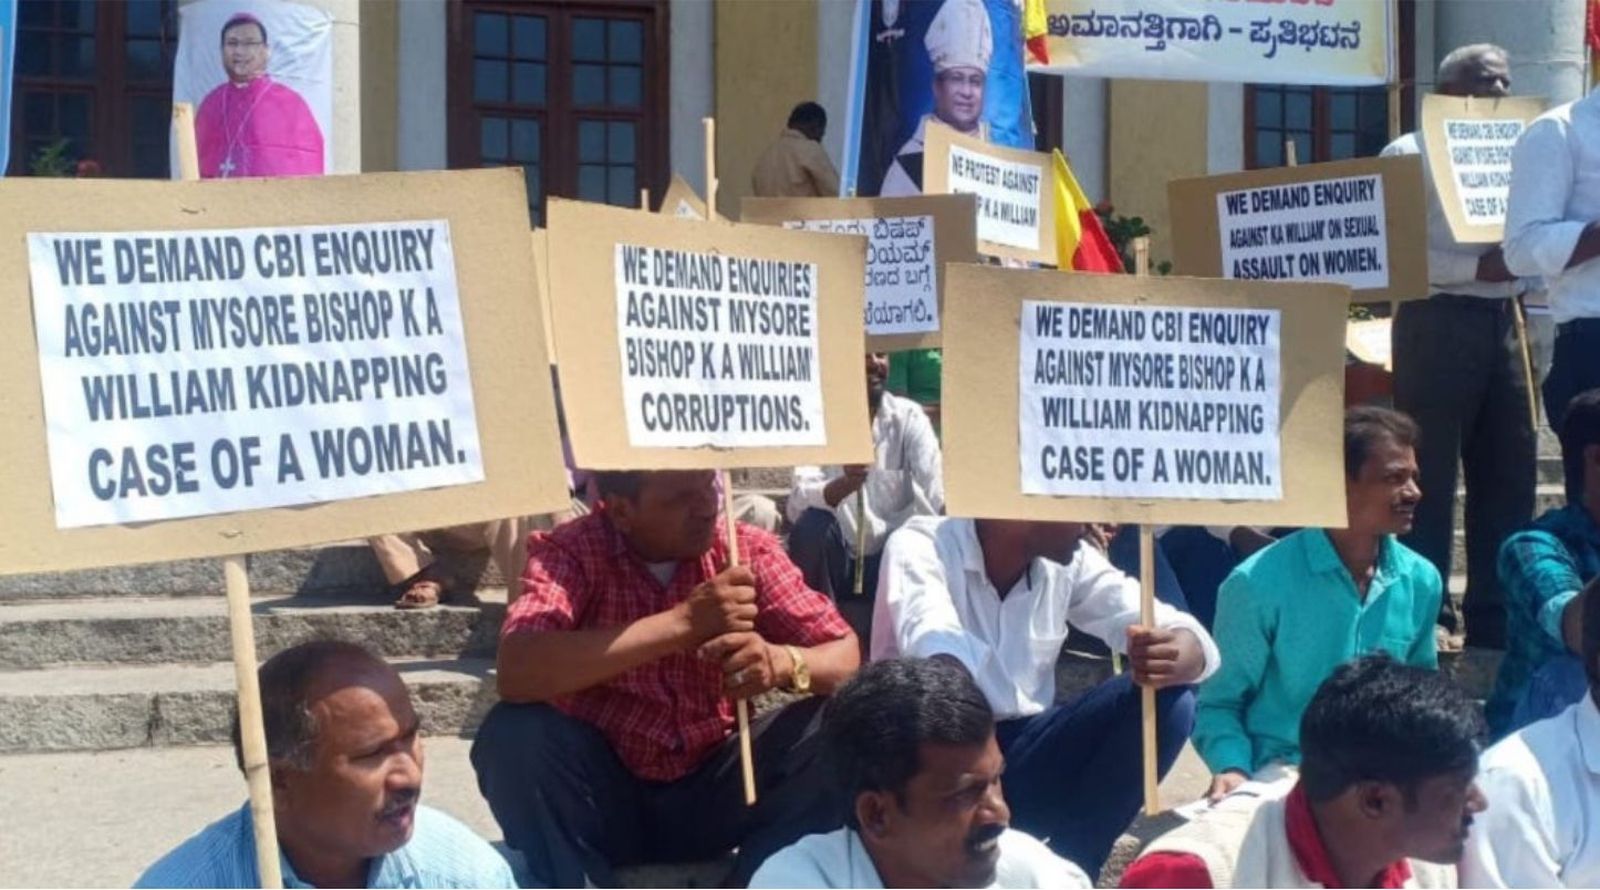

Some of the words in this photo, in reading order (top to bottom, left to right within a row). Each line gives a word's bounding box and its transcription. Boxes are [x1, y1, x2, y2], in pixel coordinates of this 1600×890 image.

[1249, 16, 1361, 58] ಪ್ರತಿಭಟನೆ
[965, 158, 1000, 185] PROTEST
[1002, 169, 1038, 194] AGAINST
[993, 200, 999, 219] A
[1001, 202, 1037, 227] WILLIAM
[1226, 193, 1248, 216] WE
[1252, 186, 1310, 213] DEMAND
[1314, 178, 1376, 206] ENQUIRY
[1230, 225, 1268, 249] AGAINST
[1328, 217, 1342, 240] ON
[1344, 214, 1380, 238] SEXUAL
[53, 239, 106, 286] WE
[114, 236, 246, 285] DEMAND
[254, 233, 305, 279] CBI
[313, 228, 435, 277] ENQUIRY
[623, 245, 648, 286] WE
[653, 248, 723, 292] DEMAND
[728, 256, 811, 299] ENQUIRIES
[1234, 254, 1296, 280] ASSAULT
[1299, 252, 1320, 277] ON
[1323, 247, 1382, 275] WOMEN.
[65, 300, 181, 357] AGAINST
[189, 295, 300, 350] MYSORE
[304, 290, 394, 343] BISHOP
[400, 288, 422, 337] K
[426, 287, 443, 335] A
[626, 290, 722, 332] AGAINST
[729, 298, 811, 337] MYSORE
[1036, 305, 1063, 338] WE
[1069, 307, 1146, 341] DEMAND
[1152, 311, 1183, 343] CBI
[1189, 313, 1270, 345] ENQUIRY
[626, 337, 695, 379] BISHOP
[701, 341, 716, 379] K
[721, 343, 734, 379] A
[1034, 348, 1104, 387] AGAINST
[1108, 352, 1174, 389] MYSORE
[1179, 354, 1235, 391] BISHOP
[1240, 356, 1251, 392] K
[1255, 357, 1266, 392] A
[81, 367, 237, 422] WILLIAM
[246, 352, 447, 410] KIDNAPPING
[641, 392, 810, 432] CORRUPTIONS.
[1042, 397, 1131, 430] WILLIAM
[1139, 400, 1264, 434] KIDNAPPING
[88, 441, 200, 501] CASE
[211, 436, 262, 490] OF
[278, 433, 304, 484] A
[311, 418, 466, 480] WOMAN.
[1042, 445, 1105, 482] CASE
[1113, 448, 1144, 483] OF
[1153, 449, 1169, 483] A
[1175, 450, 1271, 486] WOMAN.
